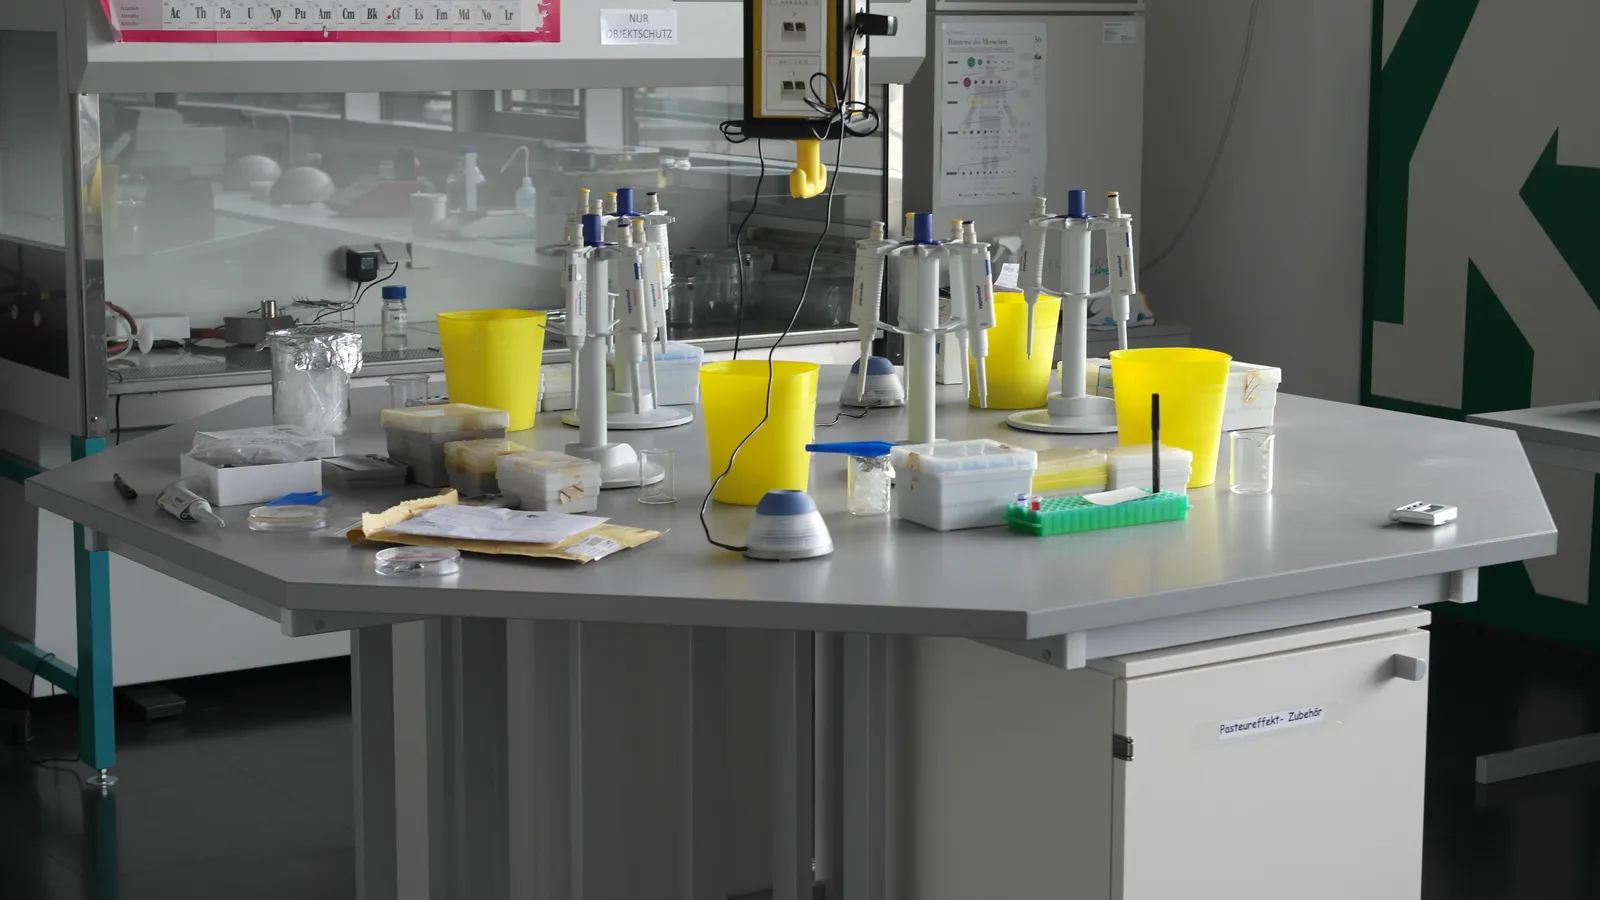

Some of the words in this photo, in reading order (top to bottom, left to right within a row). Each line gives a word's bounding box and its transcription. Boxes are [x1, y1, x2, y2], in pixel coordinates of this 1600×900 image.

[169, 7, 181, 19] Ac
[194, 7, 207, 19] Th
[219, 7, 232, 19] Pa
[247, 7, 254, 20] U
[270, 8, 282, 22] Np
[294, 8, 307, 20] Pu
[317, 8, 332, 20] Am
[342, 9, 356, 20] Cm
[366, 8, 379, 20] Bk
[436, 9, 448, 21] Fm
[458, 9, 471, 20] Md
[481, 9, 492, 21] No
[504, 10, 514, 21] Lr
[629, 14, 649, 23] NUR
[606, 29, 673, 39] OBJEKTSCHUTZ
[1220, 716, 1284, 734] Pasteureffekt-
[1288, 707, 1322, 722] Zubehör
